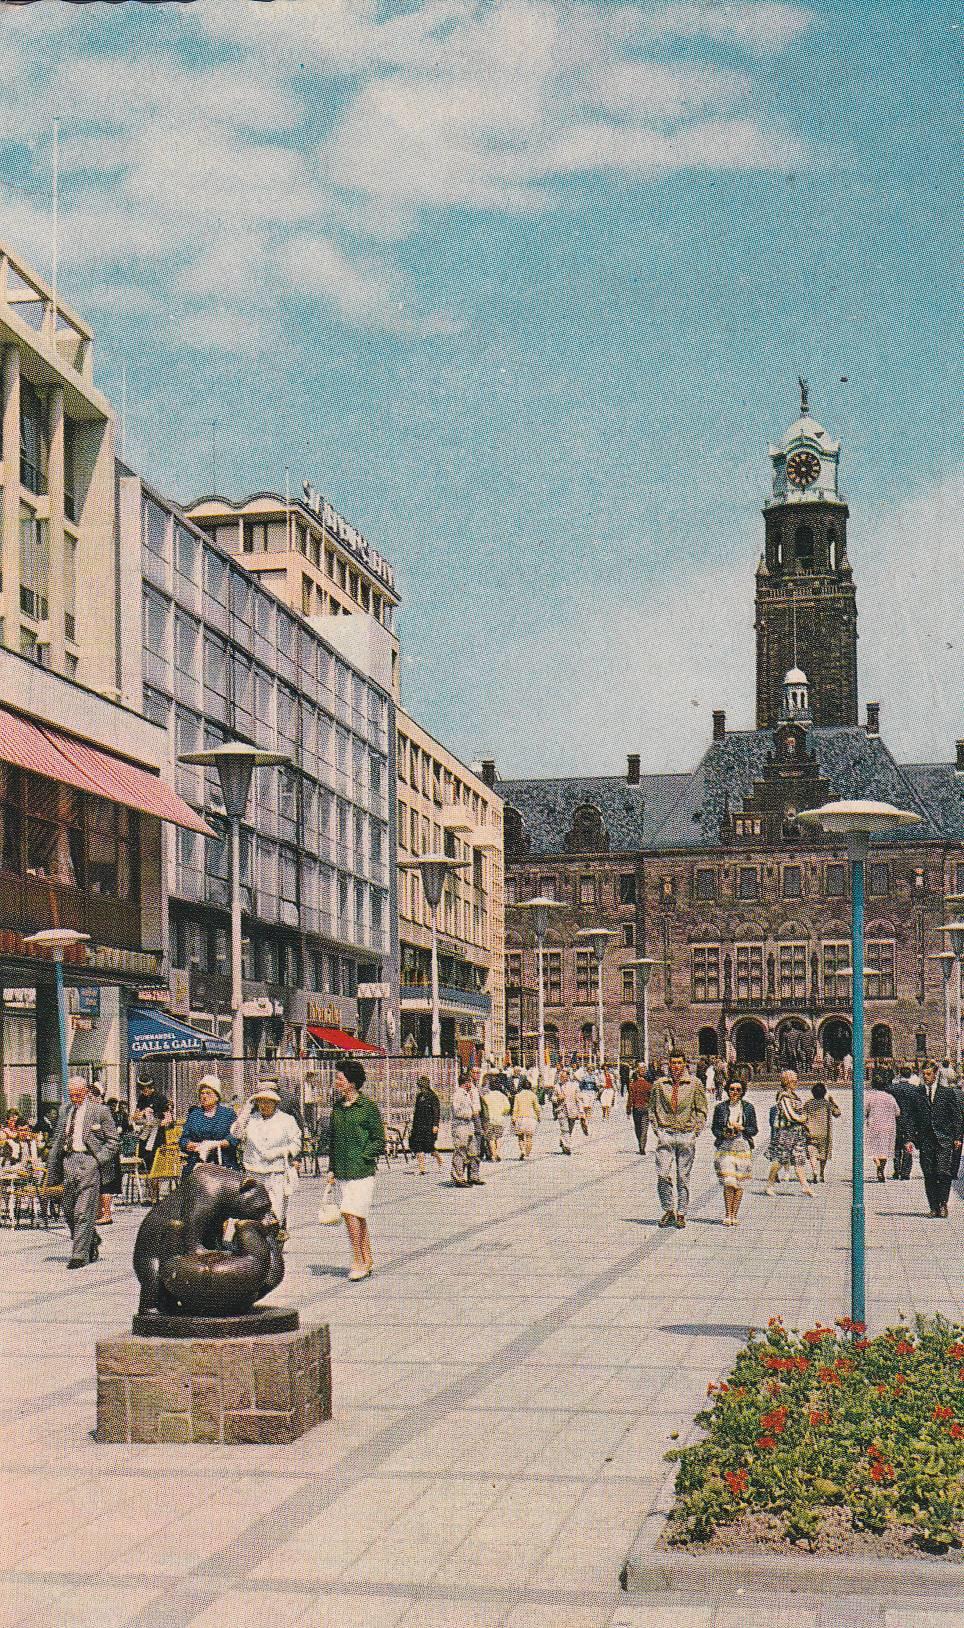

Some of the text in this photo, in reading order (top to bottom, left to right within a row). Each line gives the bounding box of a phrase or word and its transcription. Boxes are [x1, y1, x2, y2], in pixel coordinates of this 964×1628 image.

[132, 1040, 162, 1051] GALL
[163, 1041, 170, 1049] &
[171, 1038, 200, 1049] GALL
